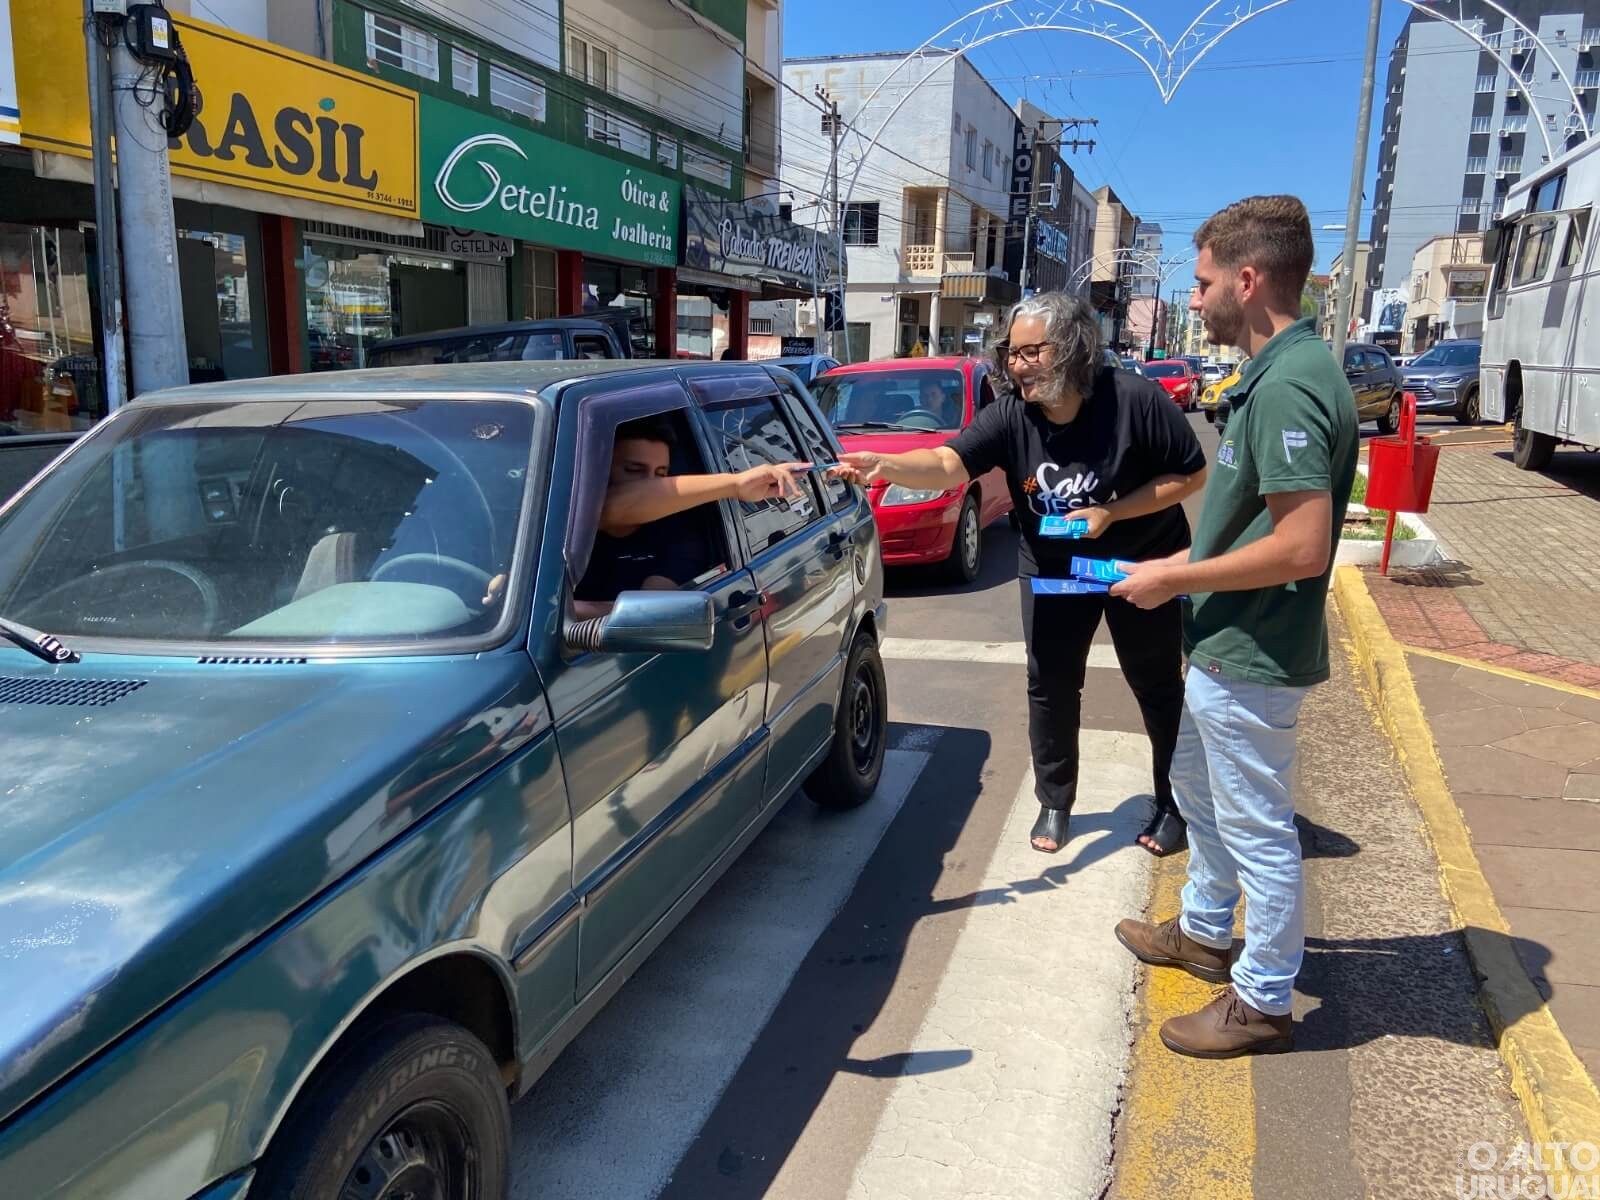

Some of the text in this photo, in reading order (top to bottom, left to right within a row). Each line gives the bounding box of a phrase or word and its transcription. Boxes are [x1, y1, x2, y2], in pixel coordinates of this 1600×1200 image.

[434, 133, 599, 230] Getelina
[621, 169, 670, 213] Ótica &
[450, 239, 509, 254] GETELINA
[611, 217, 672, 251] Joalheria
